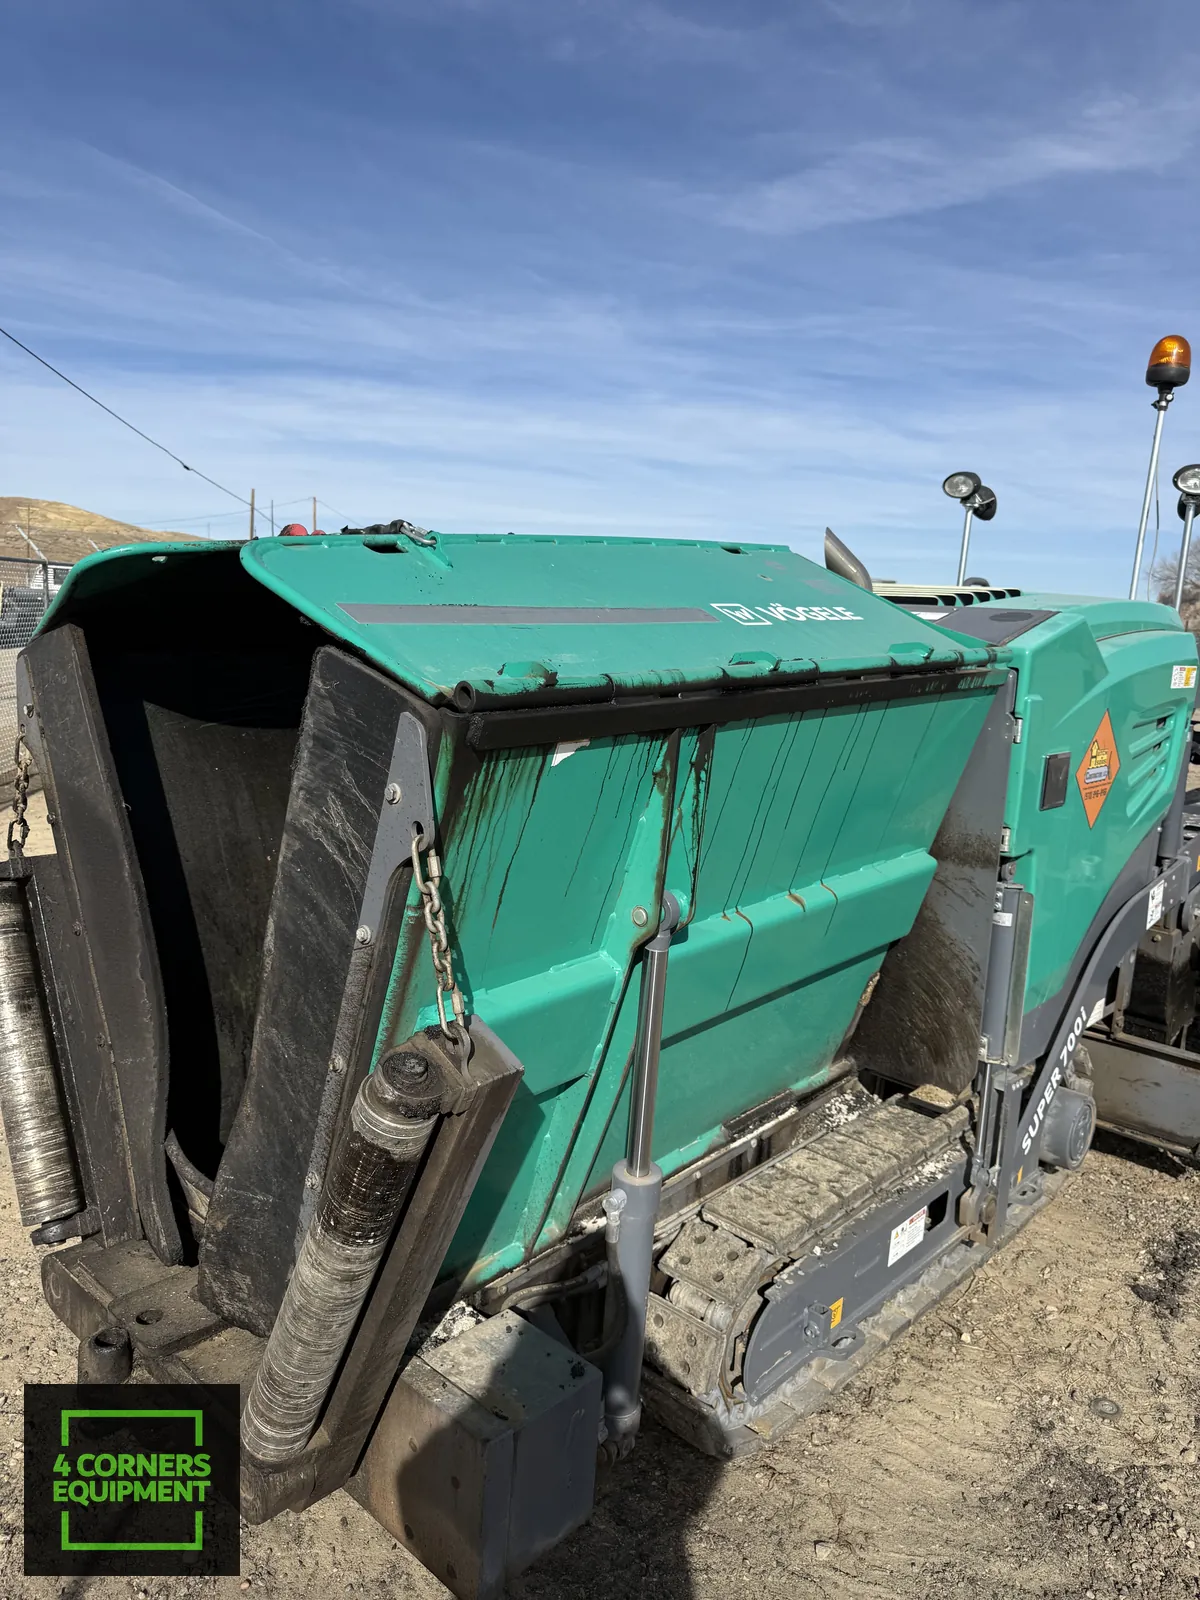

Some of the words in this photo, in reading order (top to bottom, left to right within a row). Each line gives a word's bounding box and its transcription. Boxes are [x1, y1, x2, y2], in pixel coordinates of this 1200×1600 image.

[755, 603, 864, 621] VÖGELE
[1021, 1066, 1062, 1156] SUPER
[1059, 1005, 1087, 1067] 700i
